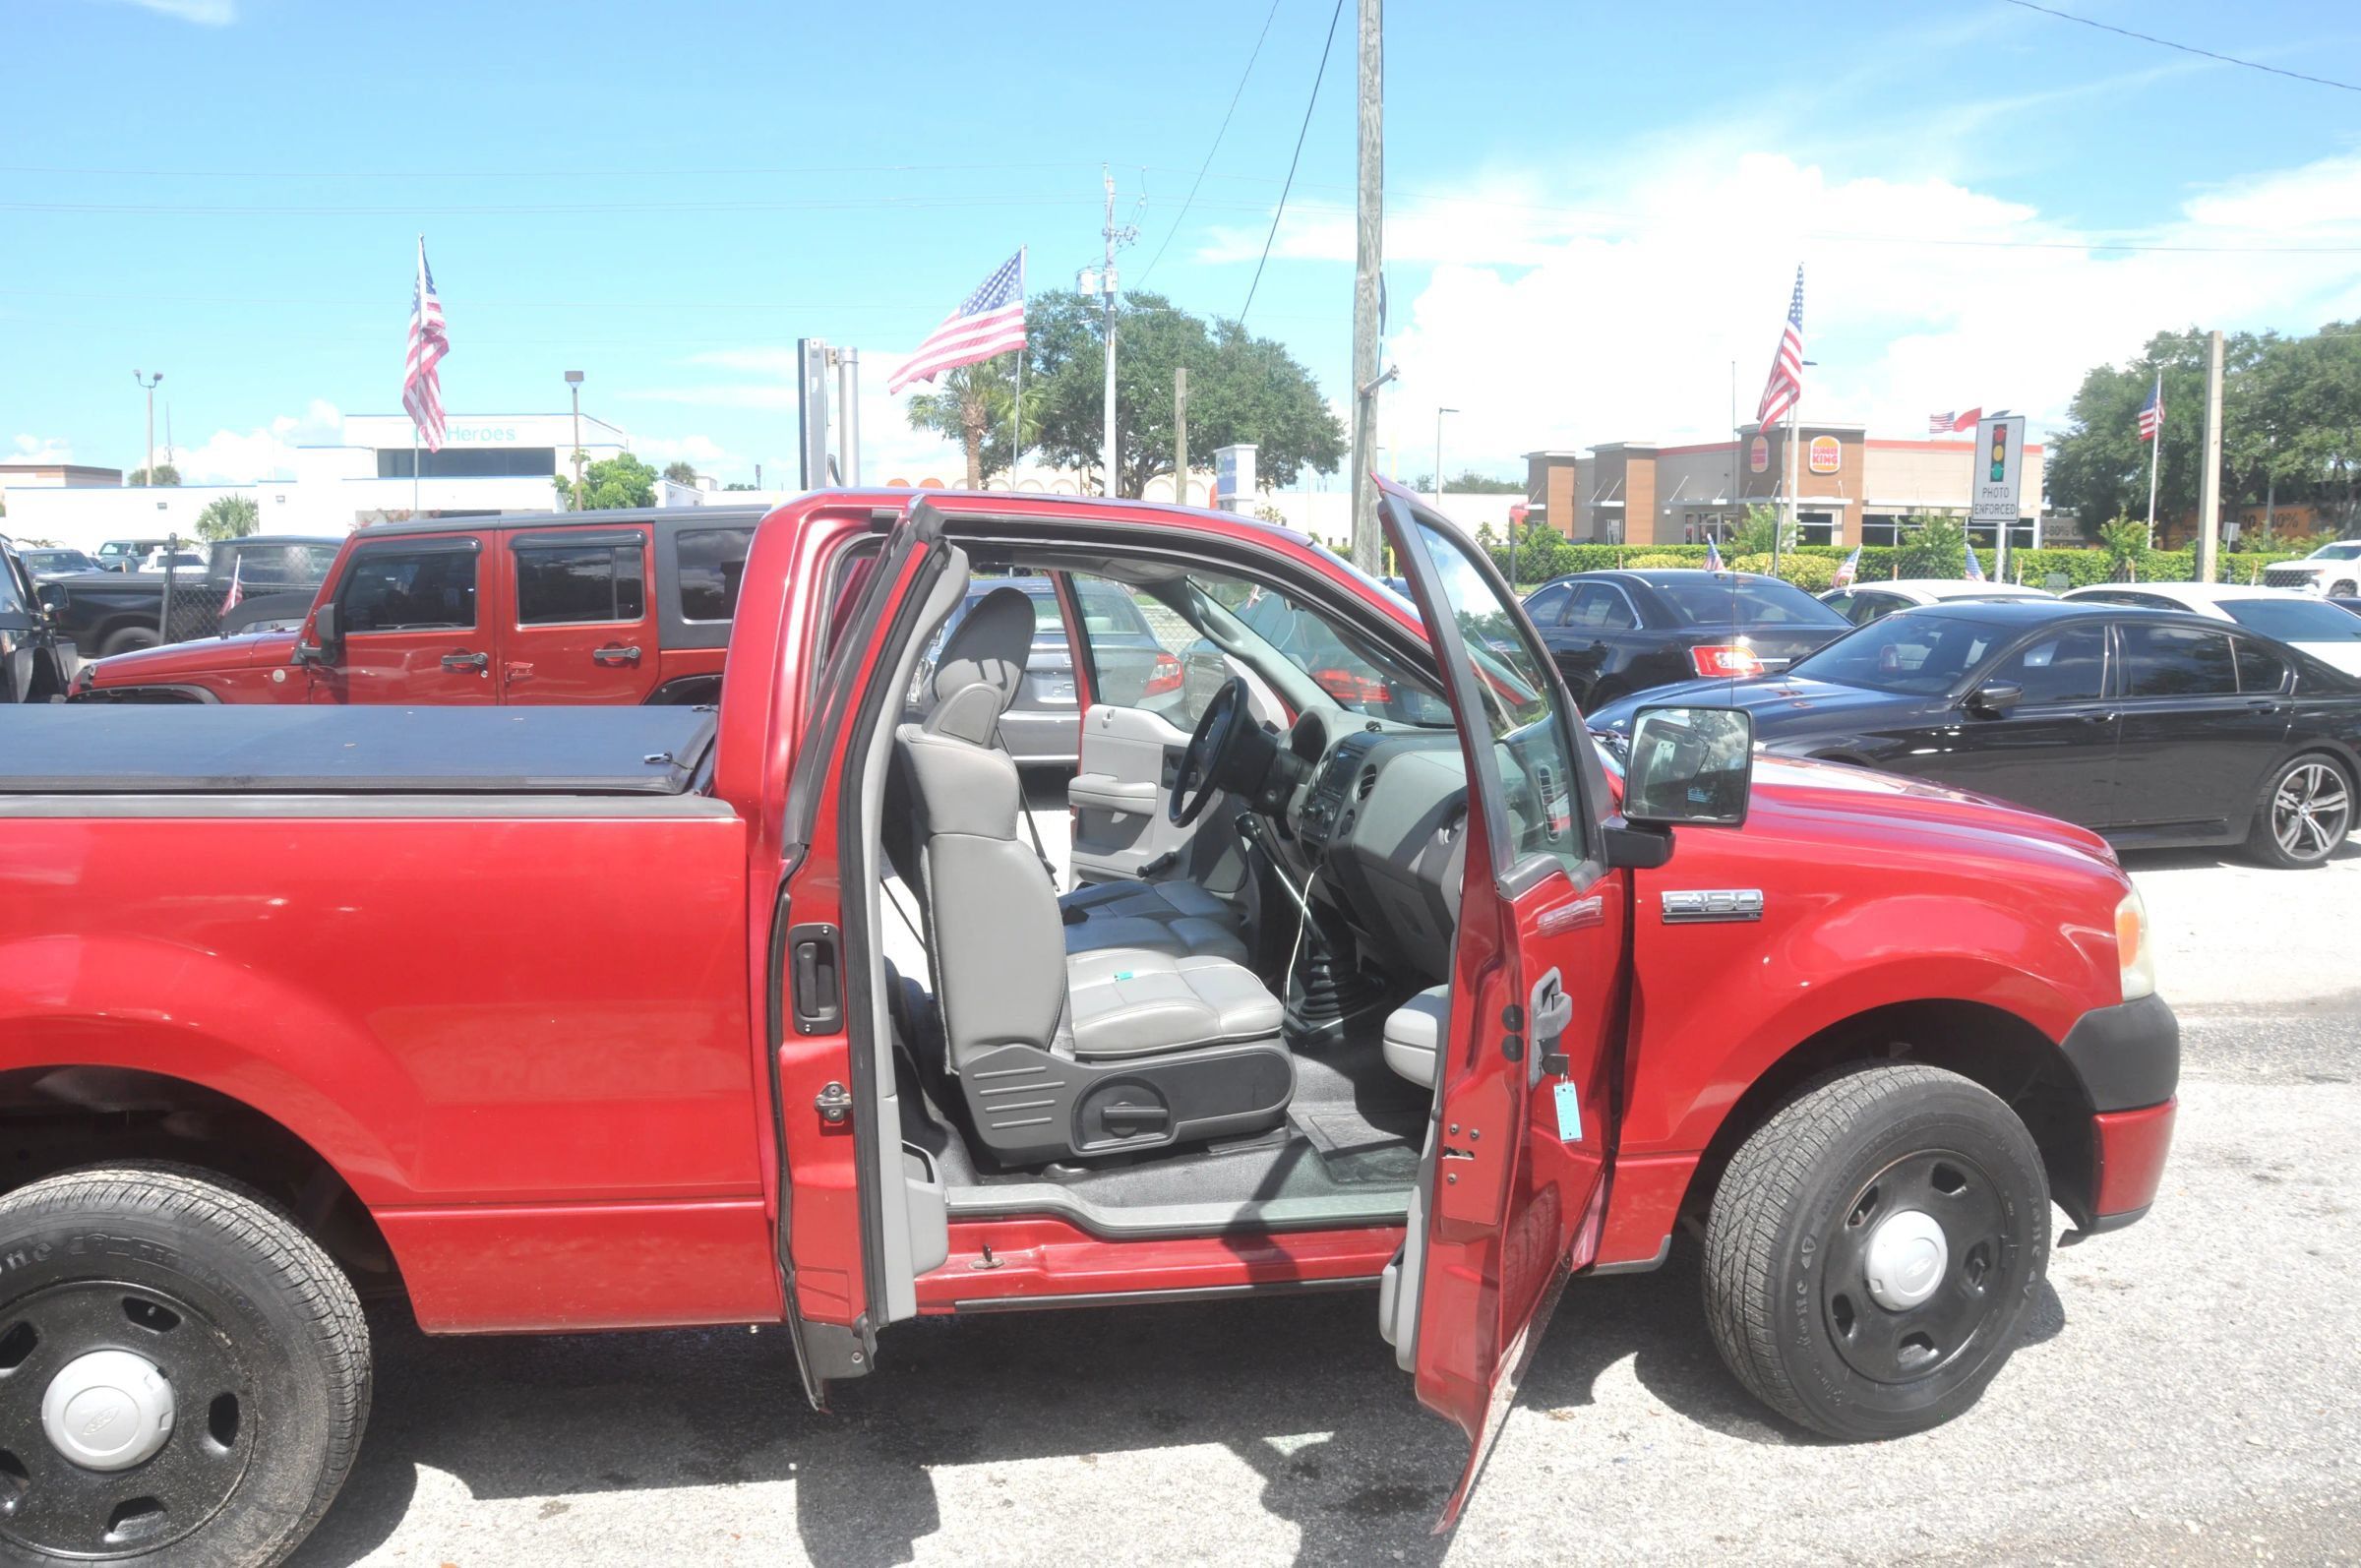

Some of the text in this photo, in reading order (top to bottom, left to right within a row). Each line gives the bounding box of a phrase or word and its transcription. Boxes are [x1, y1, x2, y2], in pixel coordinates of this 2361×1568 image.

[447, 425, 516, 442] Heroes
[1812, 454, 1839, 464] KING
[1982, 487, 2010, 499] PHOTO
[1974, 503, 2017, 515] ENFORCED
